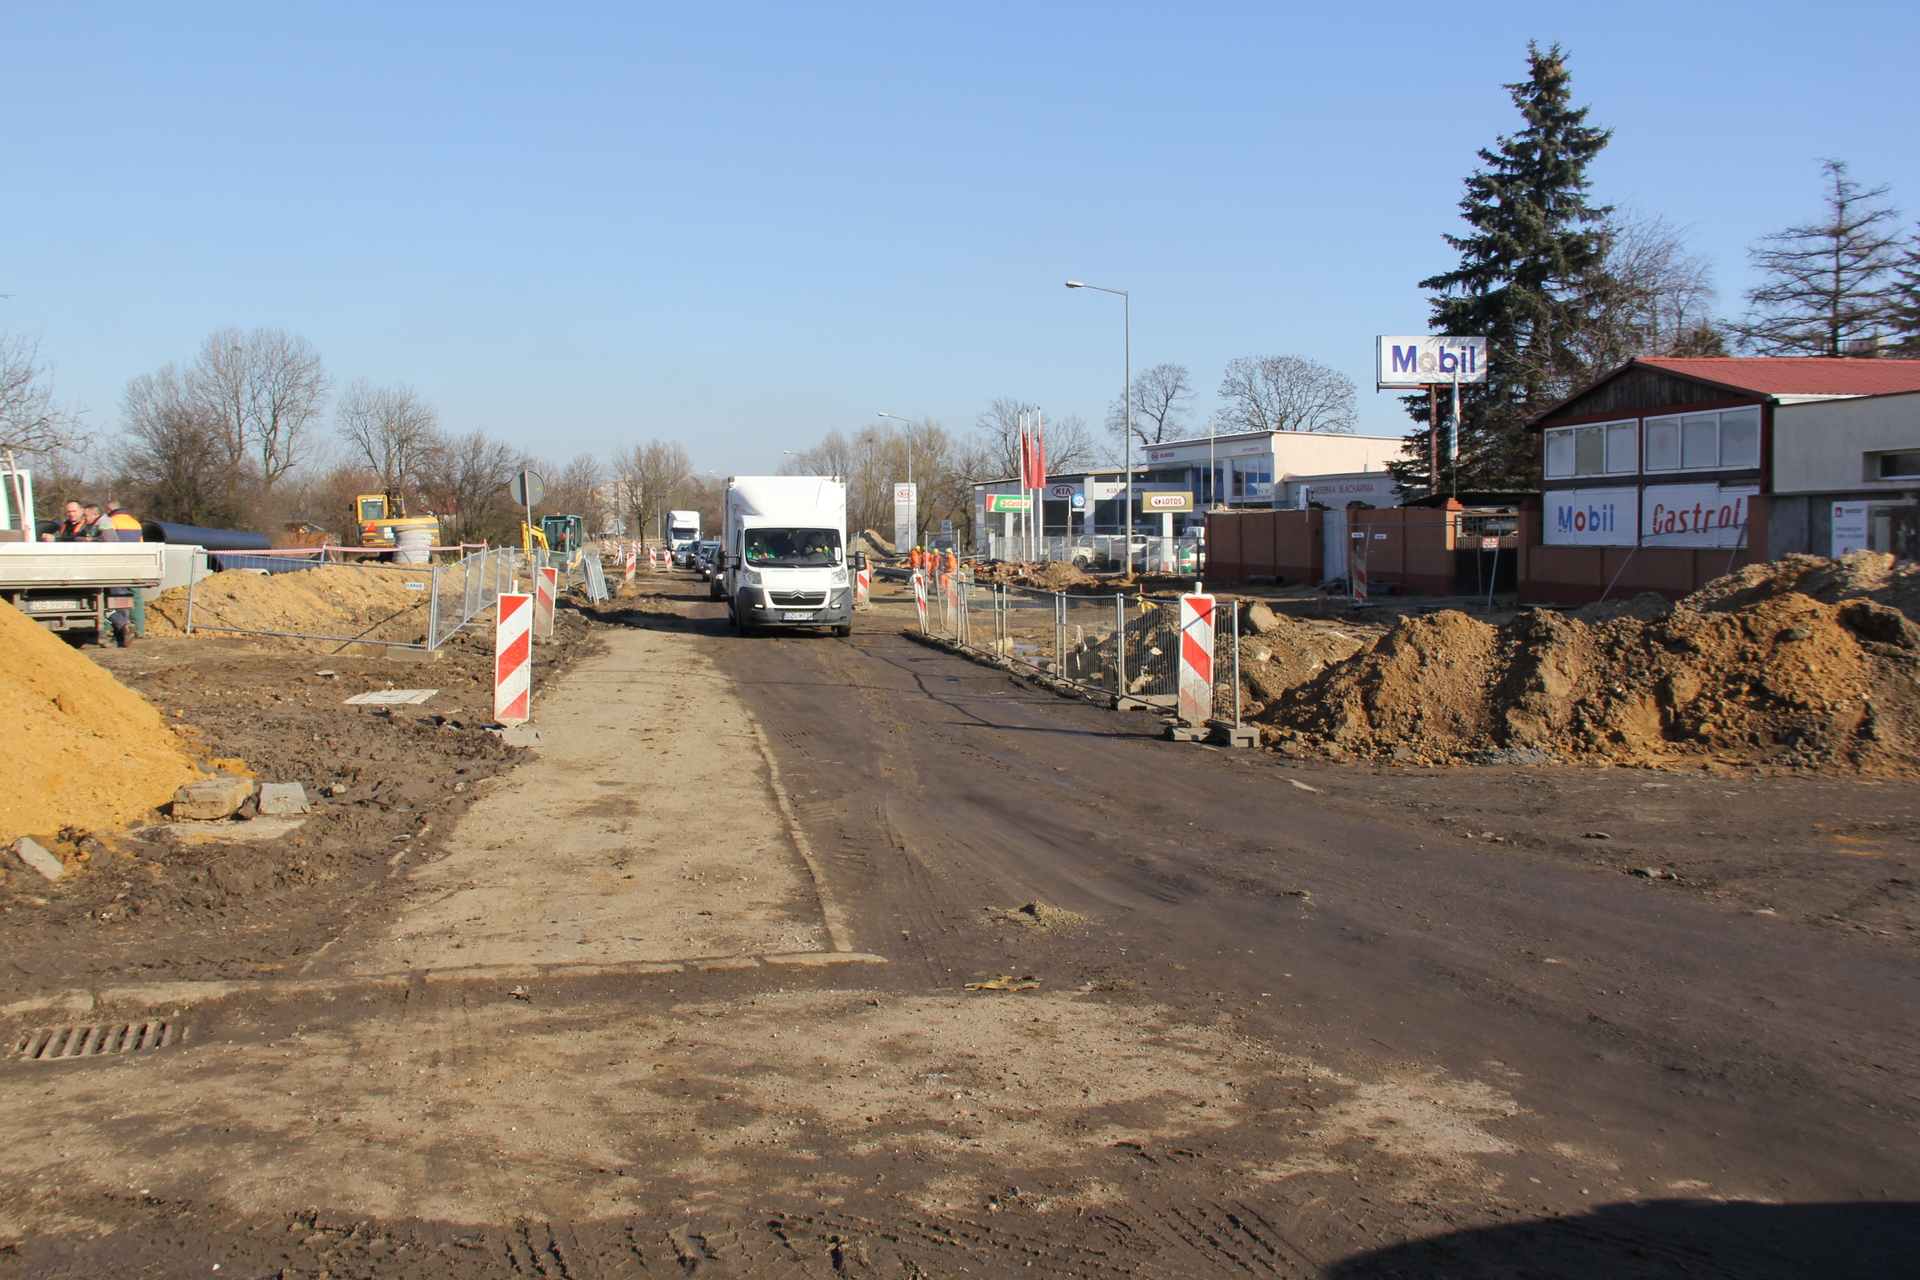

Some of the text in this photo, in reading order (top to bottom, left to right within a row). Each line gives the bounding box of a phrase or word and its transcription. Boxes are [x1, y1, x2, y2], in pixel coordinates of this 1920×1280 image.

[1392, 345, 1475, 373] Mobil
[1339, 484, 1374, 494] BLACHARNIA
[1558, 504, 1614, 533] Mobil
[1653, 498, 1741, 534] Castrol
